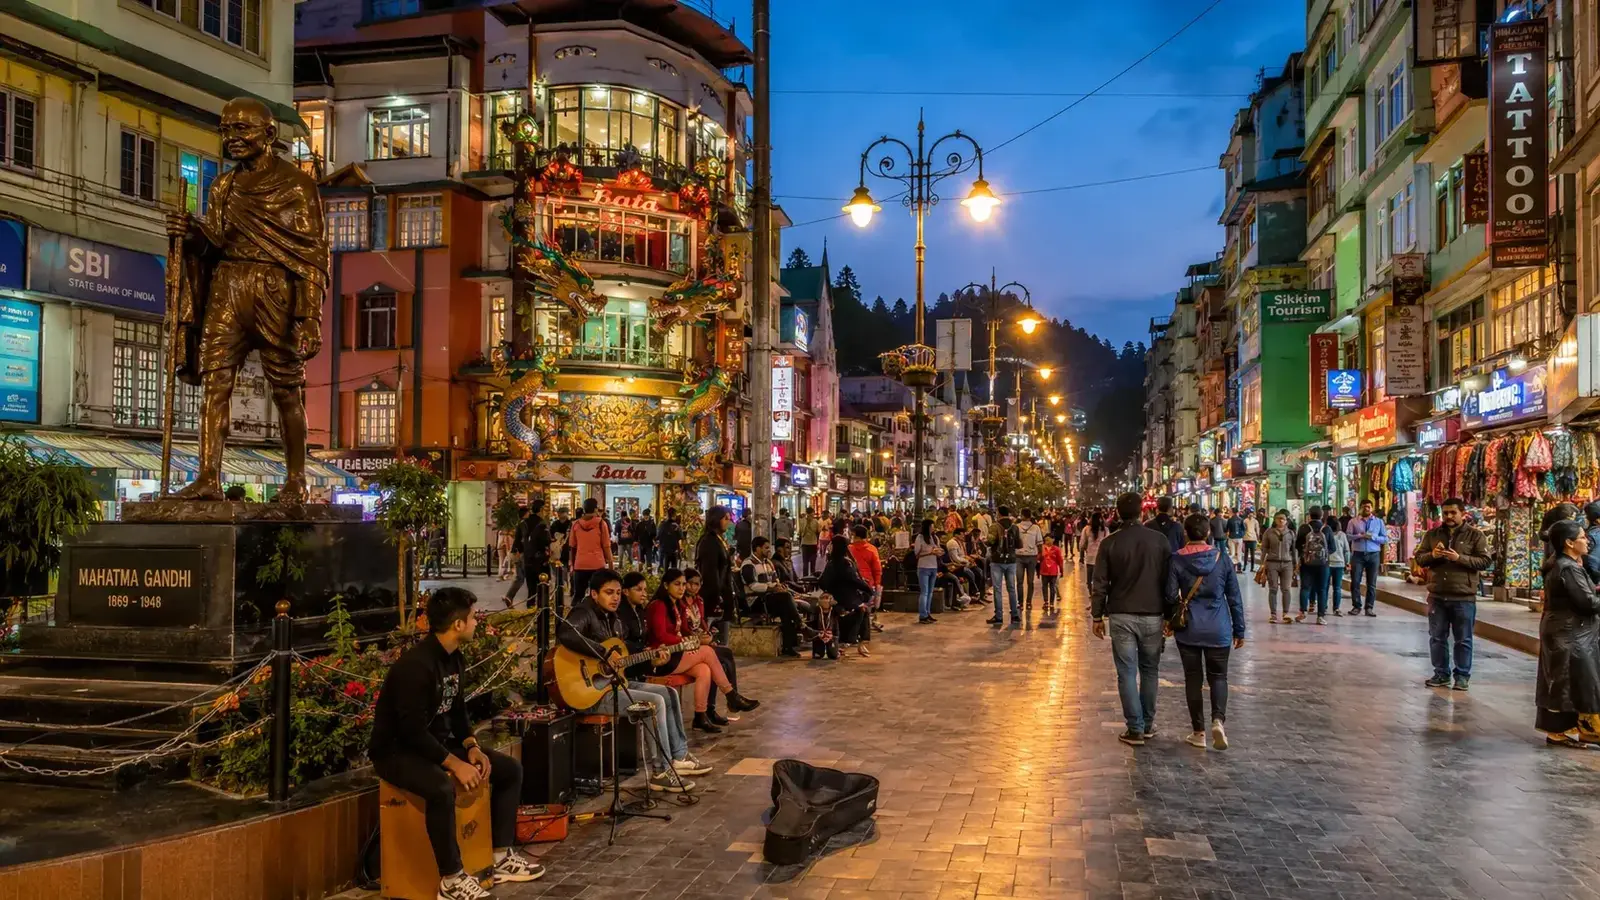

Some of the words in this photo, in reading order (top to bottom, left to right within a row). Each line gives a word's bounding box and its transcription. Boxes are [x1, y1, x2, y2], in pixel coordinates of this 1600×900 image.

[1505, 52, 1535, 215] TATTOO
[589, 188, 660, 213] Bata
[68, 247, 111, 279] SBI
[68, 277, 95, 291] STATE
[96, 283, 120, 296] BANK
[121, 288, 133, 298] OF
[133, 290, 156, 303] INDIA
[1274, 293, 1321, 305] Sikkim
[1266, 304, 1326, 316] Tourism
[592, 464, 647, 480] Bata
[78, 568, 139, 587] MAHATMA
[143, 569, 192, 588] GANDHI
[107, 595, 129, 607] 1869
[140, 595, 162, 608] 1948
